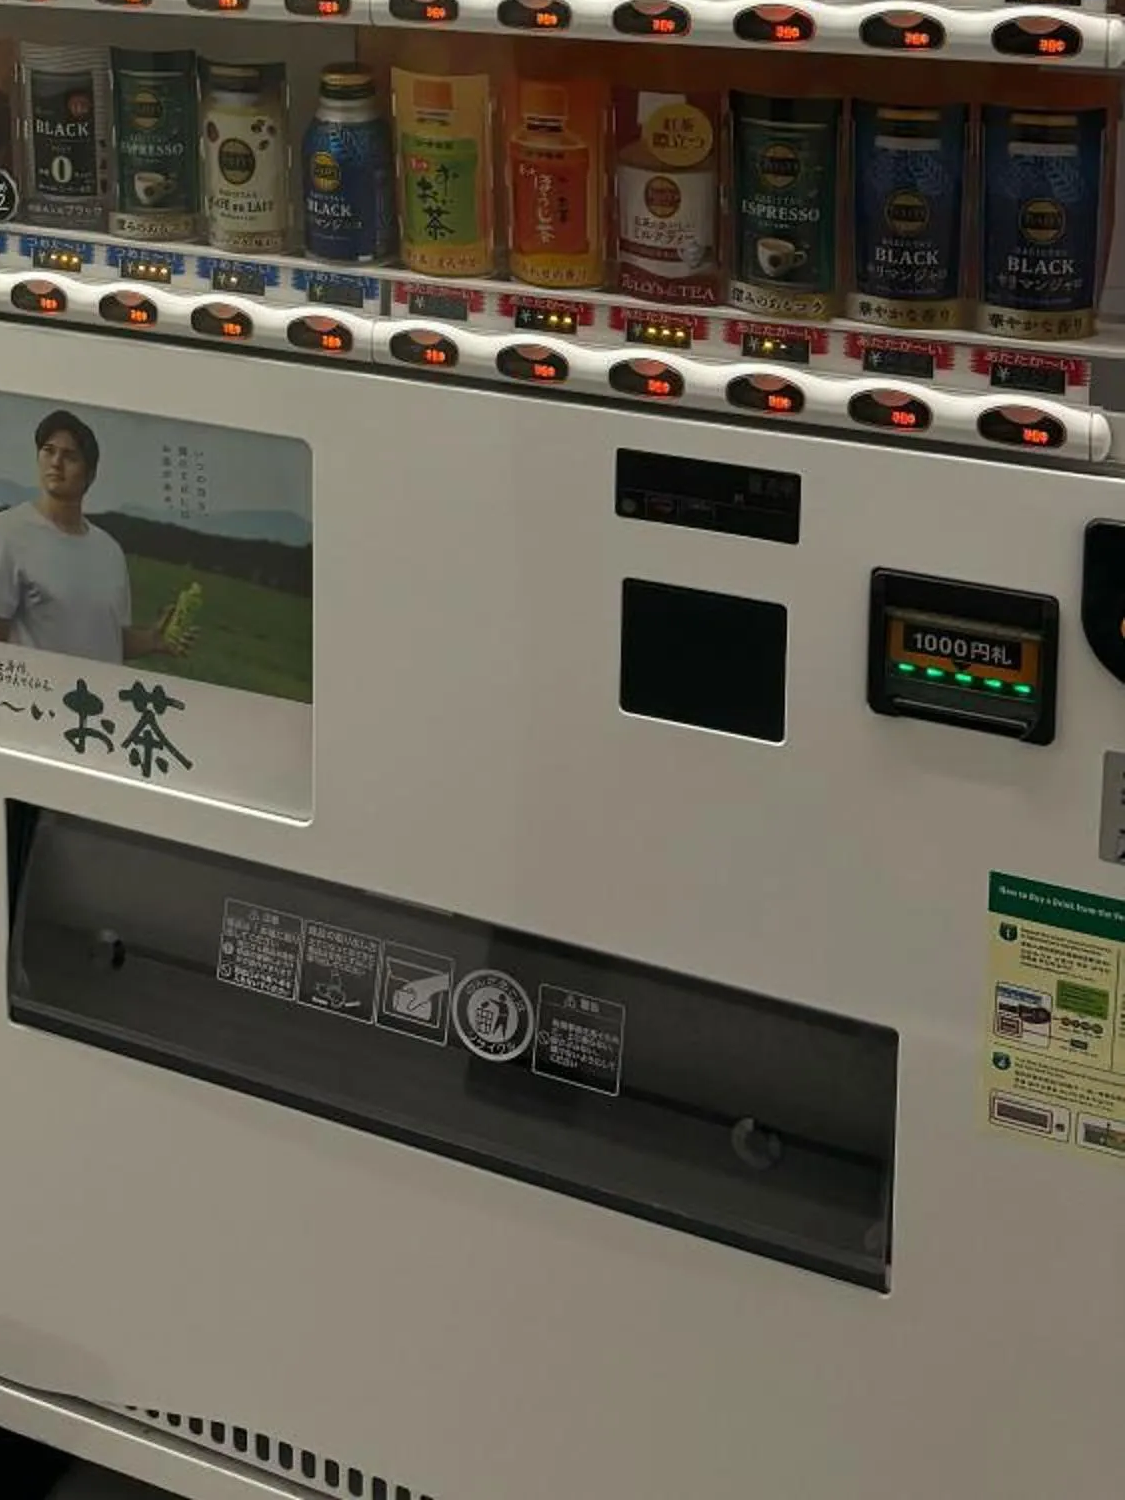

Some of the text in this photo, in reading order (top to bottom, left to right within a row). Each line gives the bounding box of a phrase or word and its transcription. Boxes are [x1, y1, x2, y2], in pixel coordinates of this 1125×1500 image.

[36, 119, 89, 138] BLACK
[50, 155, 73, 184] 0
[416, 176, 457, 241] お茶
[741, 199, 821, 223] ESPRESSO
[874, 247, 940, 266] BLACK
[1006, 254, 1075, 276] BLACK
[913, 631, 1012, 666] 1000円札
